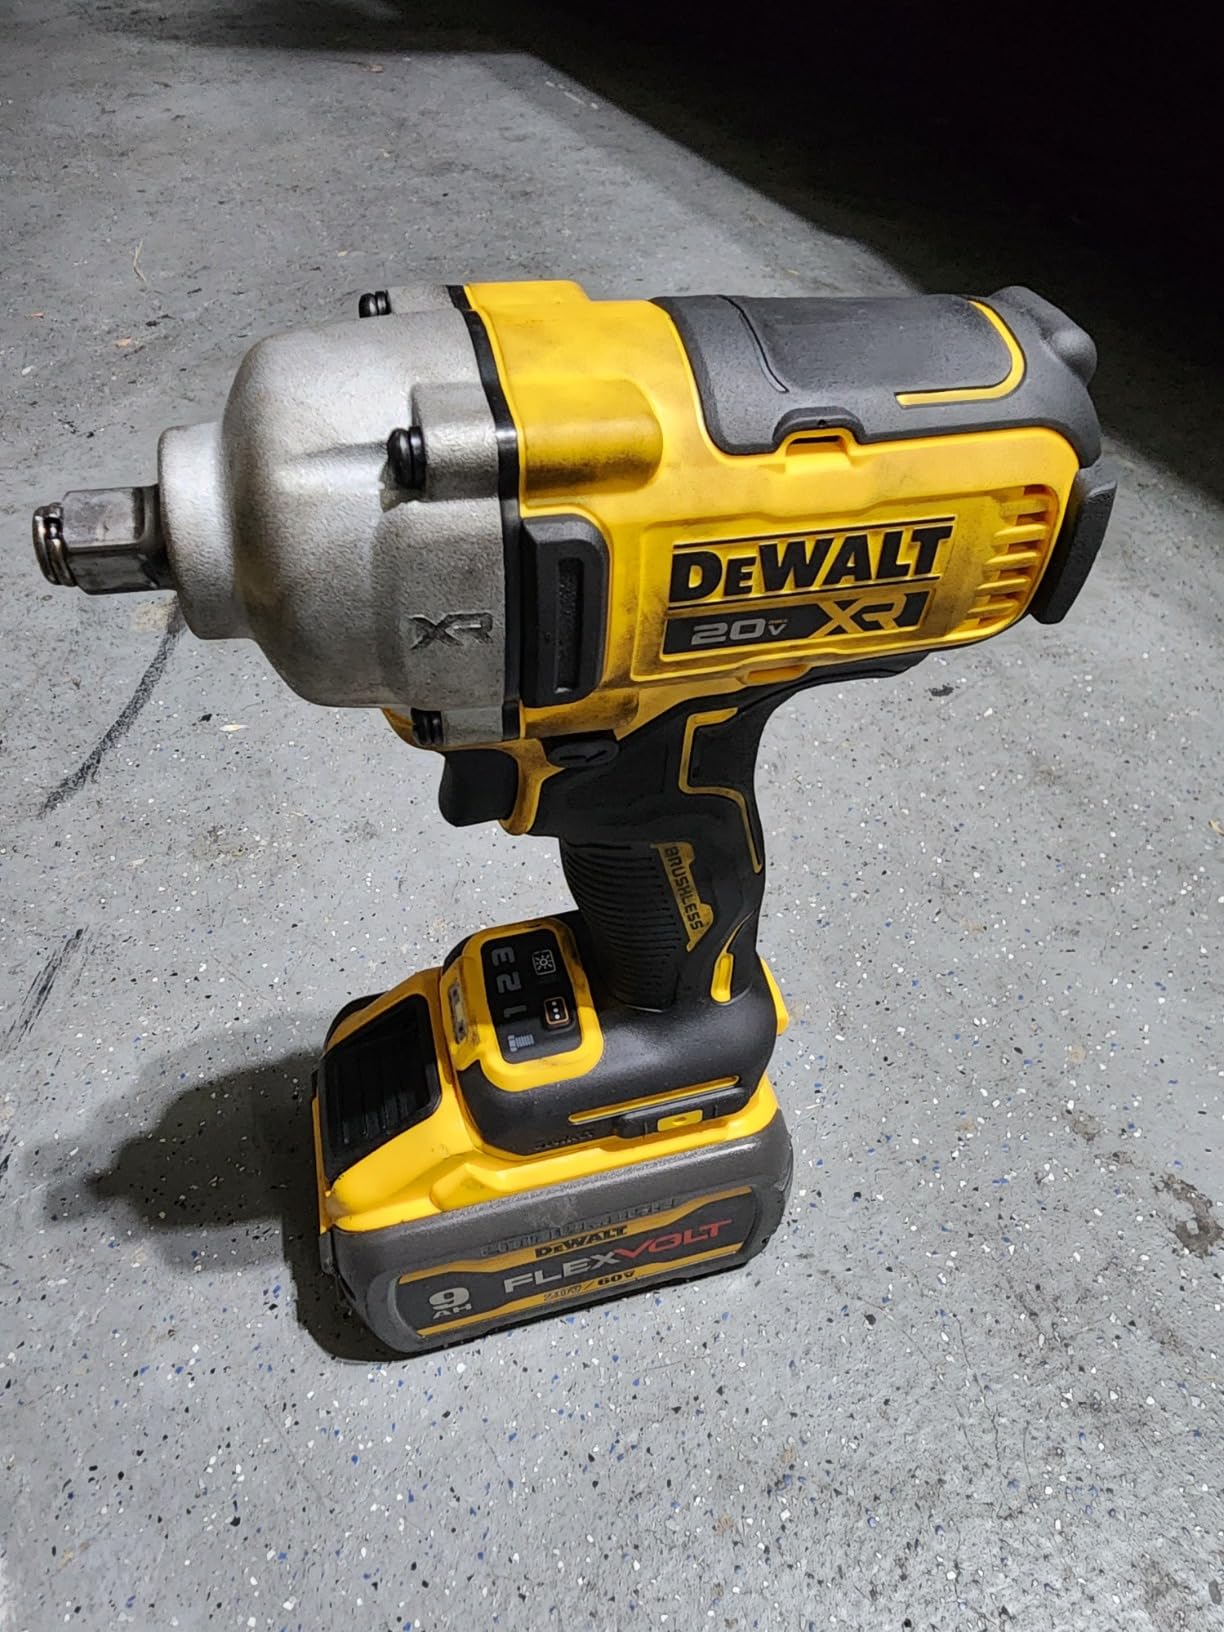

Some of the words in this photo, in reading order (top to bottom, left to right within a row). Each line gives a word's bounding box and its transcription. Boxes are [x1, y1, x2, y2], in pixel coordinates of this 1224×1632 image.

[669, 525, 953, 602] DEWALT
[407, 611, 494, 651] XR
[808, 591, 908, 640] XR
[664, 846, 705, 930] BRUSHLESS
[491, 946, 516, 967] 3
[496, 971, 522, 994] 2
[503, 1004, 527, 1018] 1
[504, 1219, 733, 1294] FLEXVOLT
[535, 1226, 628, 1258] DEWALT
[429, 1287, 470, 1310] 9
[432, 1303, 473, 1320] AH
